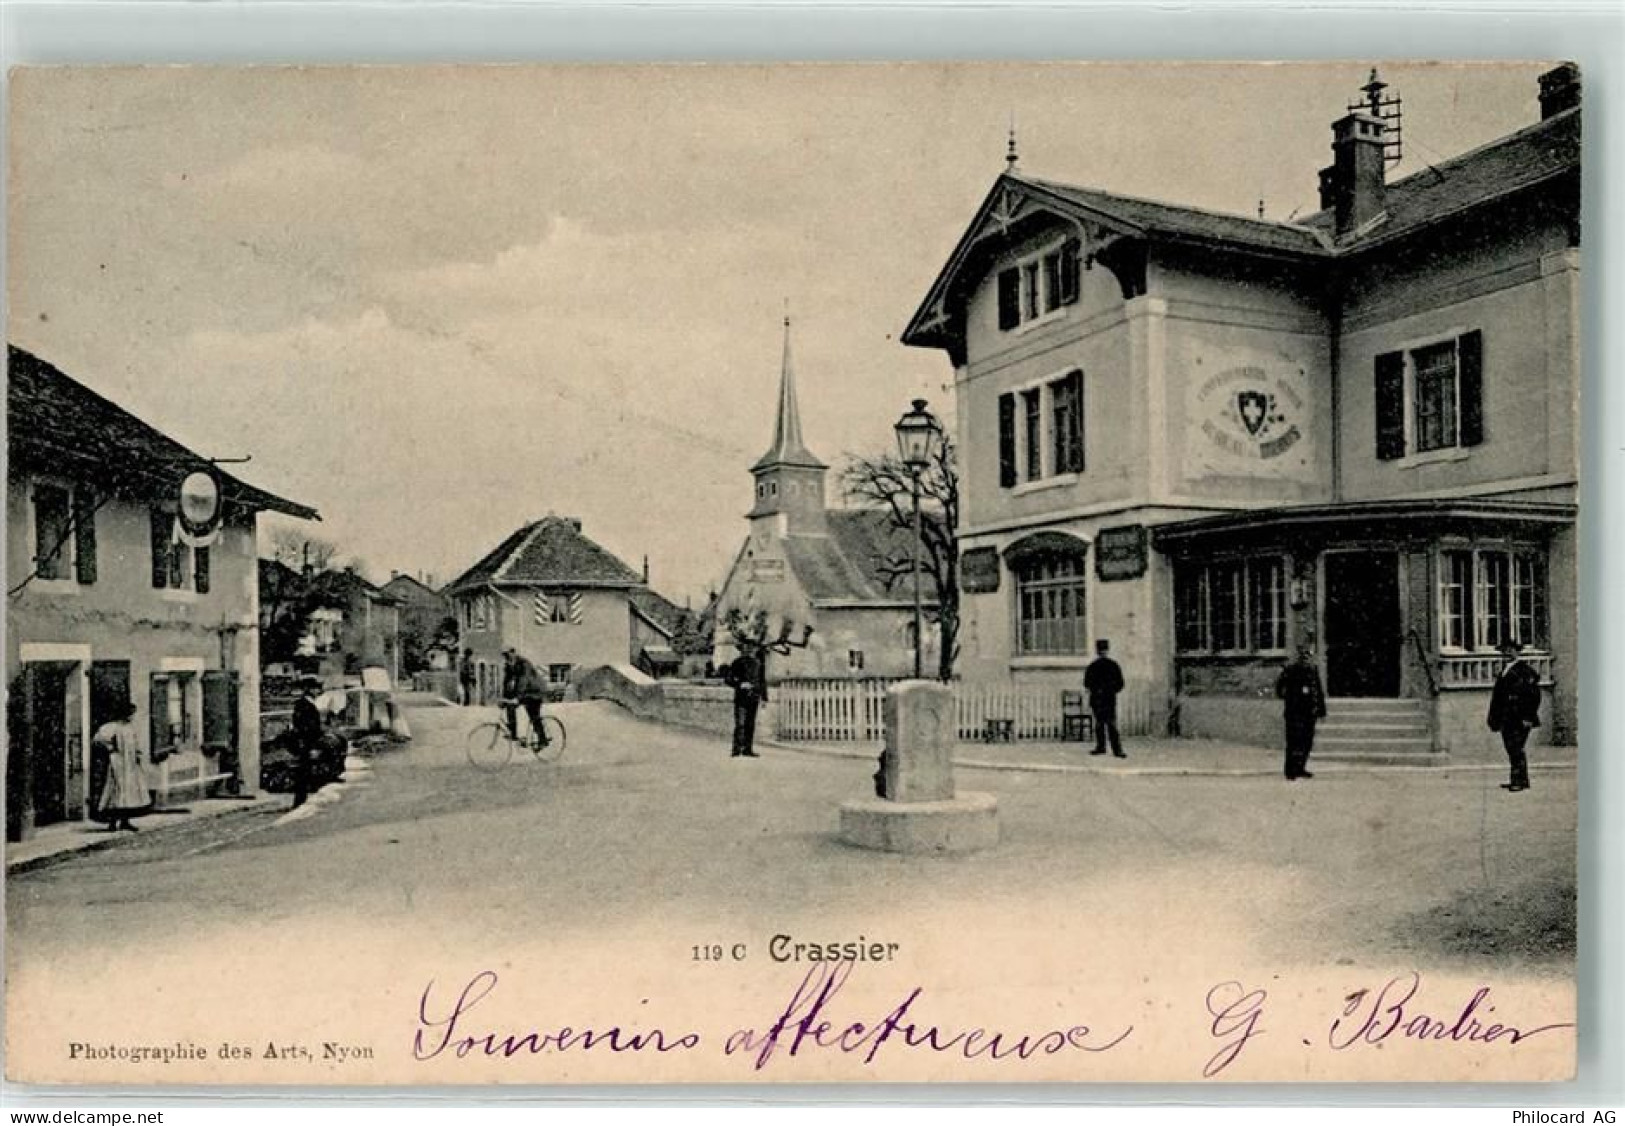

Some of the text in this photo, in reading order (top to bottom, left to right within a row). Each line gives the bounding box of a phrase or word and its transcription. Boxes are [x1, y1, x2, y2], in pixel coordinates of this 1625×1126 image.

[692, 934, 899, 962] 119 C Crassier
[68, 1042, 375, 1063] Photographie des Arts, Nyon
